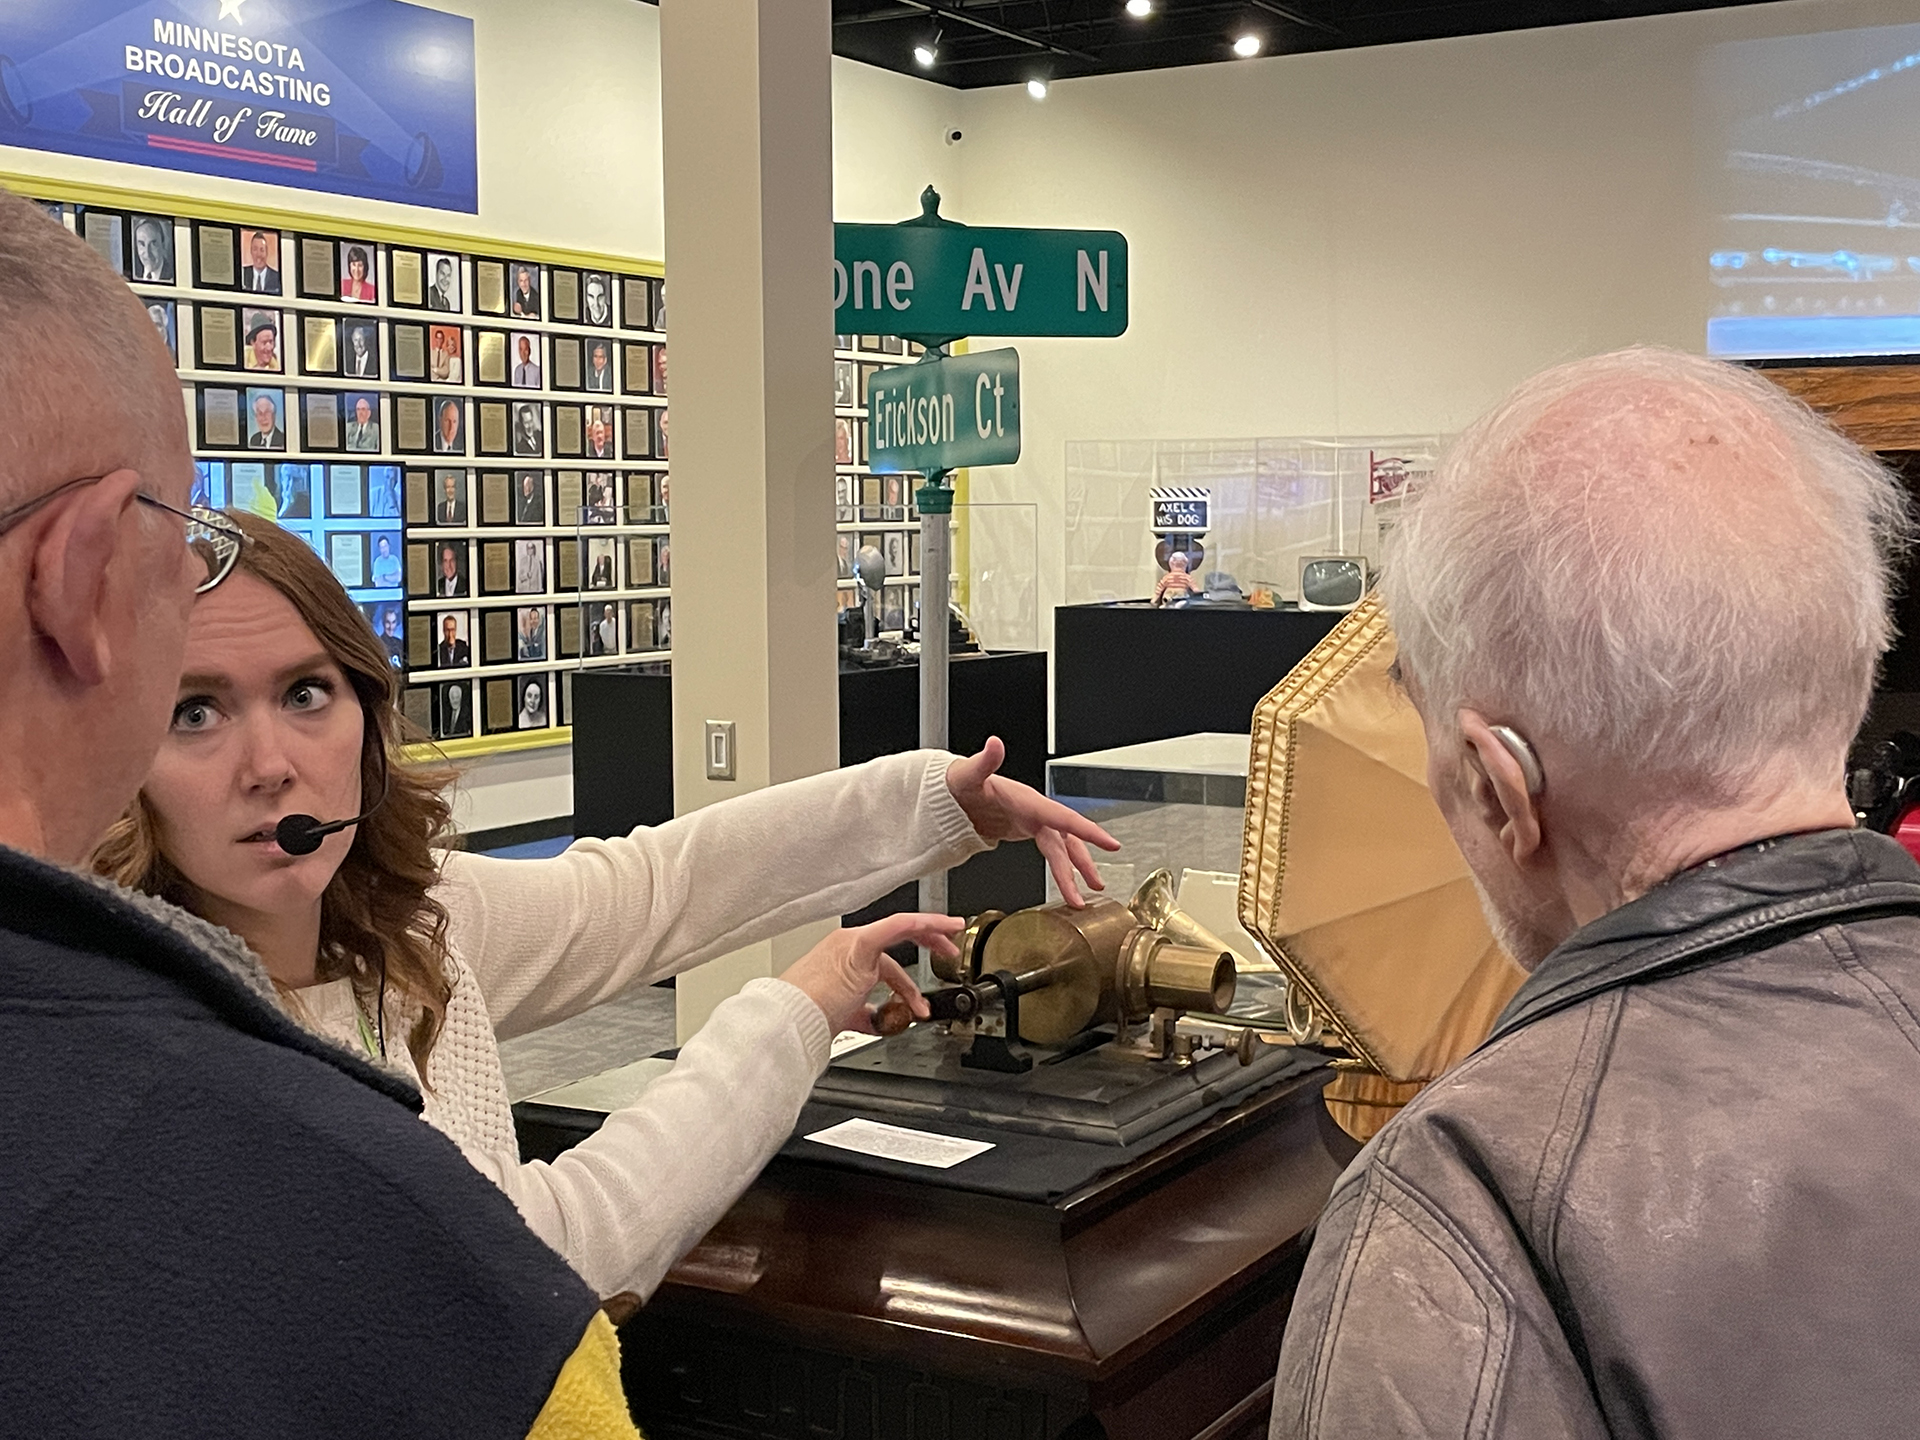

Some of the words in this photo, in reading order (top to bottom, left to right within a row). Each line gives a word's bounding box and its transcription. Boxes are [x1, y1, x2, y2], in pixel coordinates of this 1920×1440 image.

[153, 18, 305, 72] MINNESOTA
[125, 45, 331, 107] BROADCASTING
[138, 90, 213, 128] Hall
[213, 107, 252, 143] of
[255, 110, 318, 146] Fame
[961, 247, 1023, 311] Av
[1077, 249, 1108, 312] N
[875, 385, 955, 450] Erickson
[975, 372, 1005, 439] Ct
[1158, 502, 1188, 513] AXEL
[1177, 513, 1200, 525] DOG
